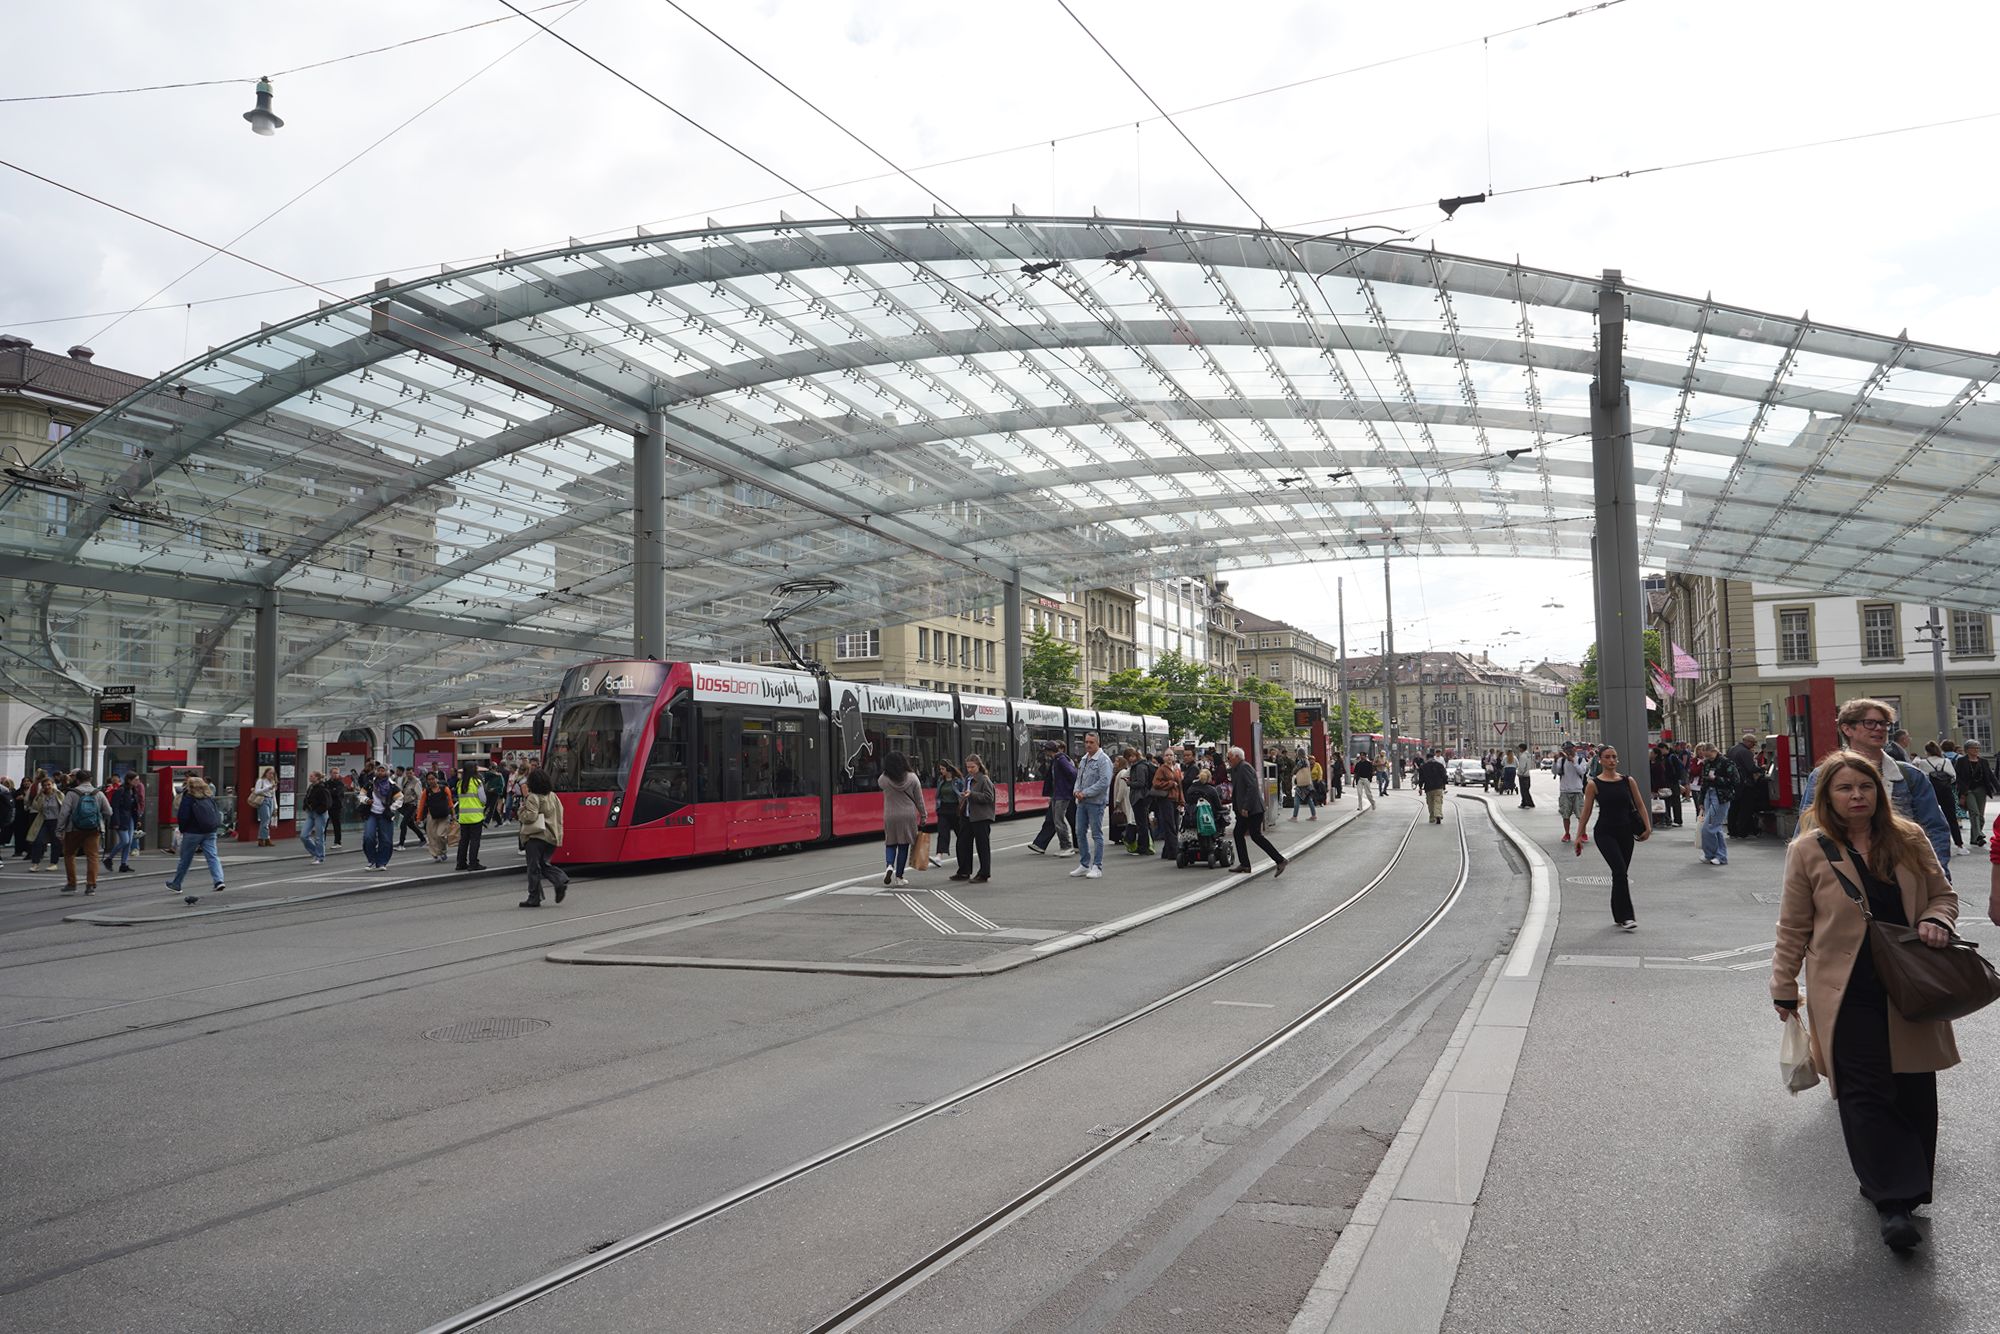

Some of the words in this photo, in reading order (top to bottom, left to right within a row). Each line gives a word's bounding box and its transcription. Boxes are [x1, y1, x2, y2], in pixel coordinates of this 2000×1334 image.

[582, 677, 590, 691] 8
[696, 672, 759, 695] bossbern
[761, 676, 798, 704] Digital
[863, 685, 896, 712] Tram
[585, 797, 602, 806] 661
